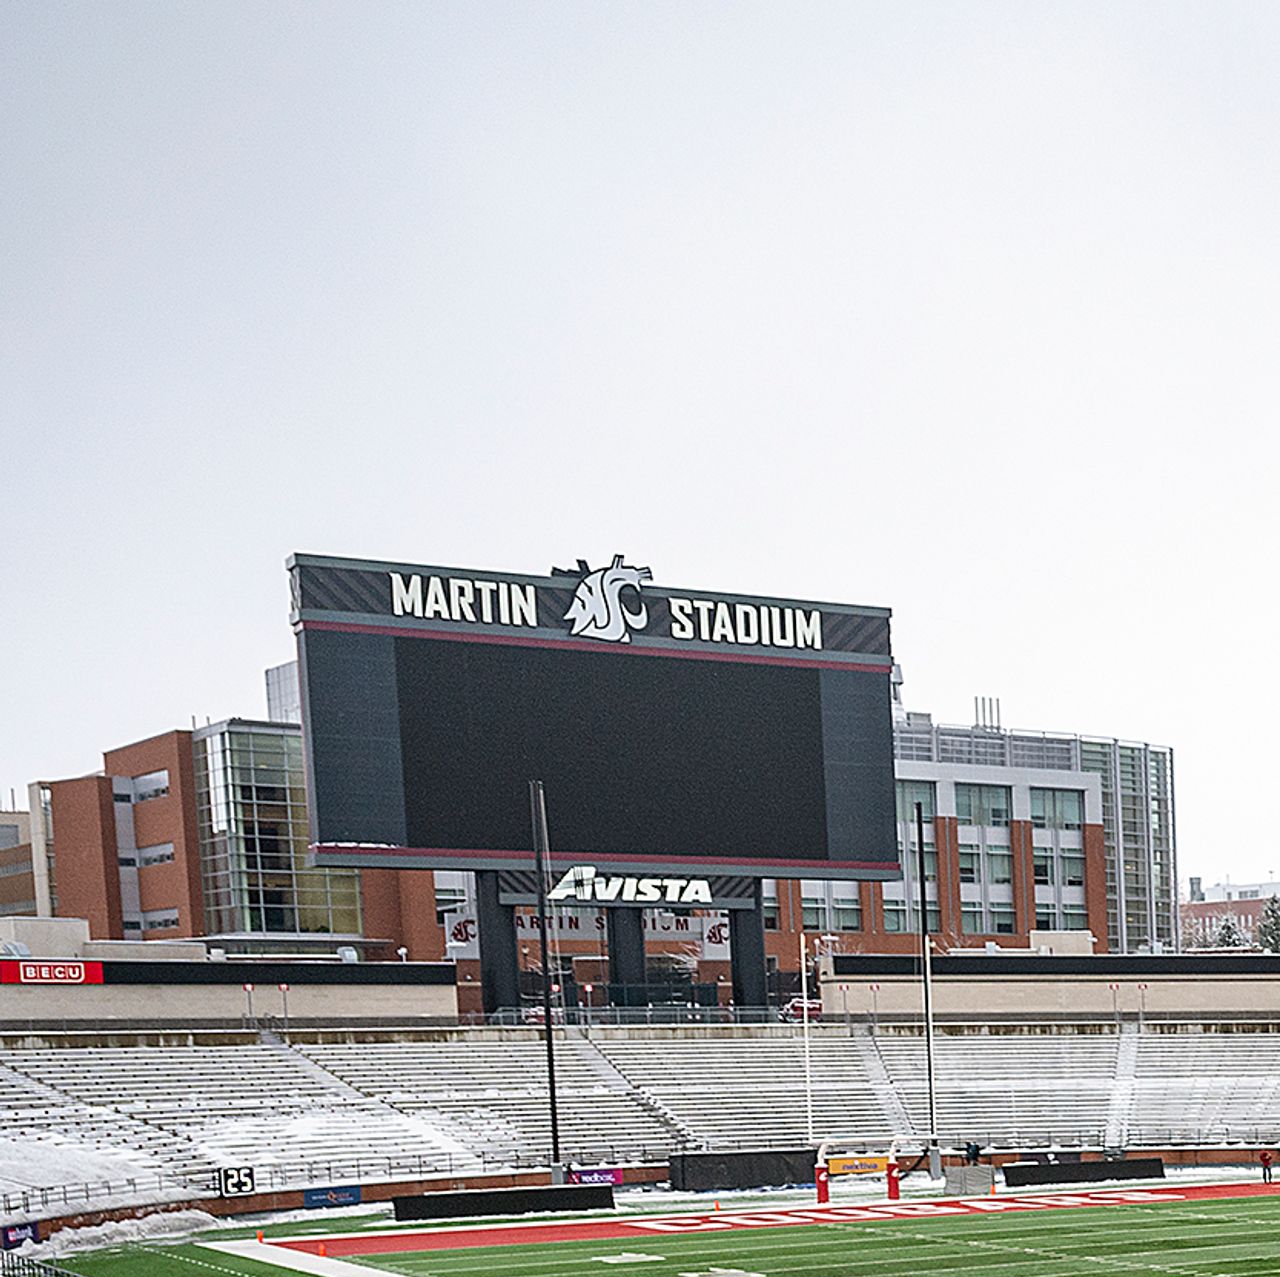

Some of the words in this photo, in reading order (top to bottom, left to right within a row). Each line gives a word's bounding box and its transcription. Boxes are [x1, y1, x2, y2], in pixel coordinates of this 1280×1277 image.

[388, 572, 537, 628] MARTIN
[668, 597, 823, 650] STADIUM
[547, 865, 713, 903] AVISTA
[515, 915, 580, 931] ARTIN
[227, 1167, 252, 1193] 25
[621, 1190, 1187, 1232] COUGARS
